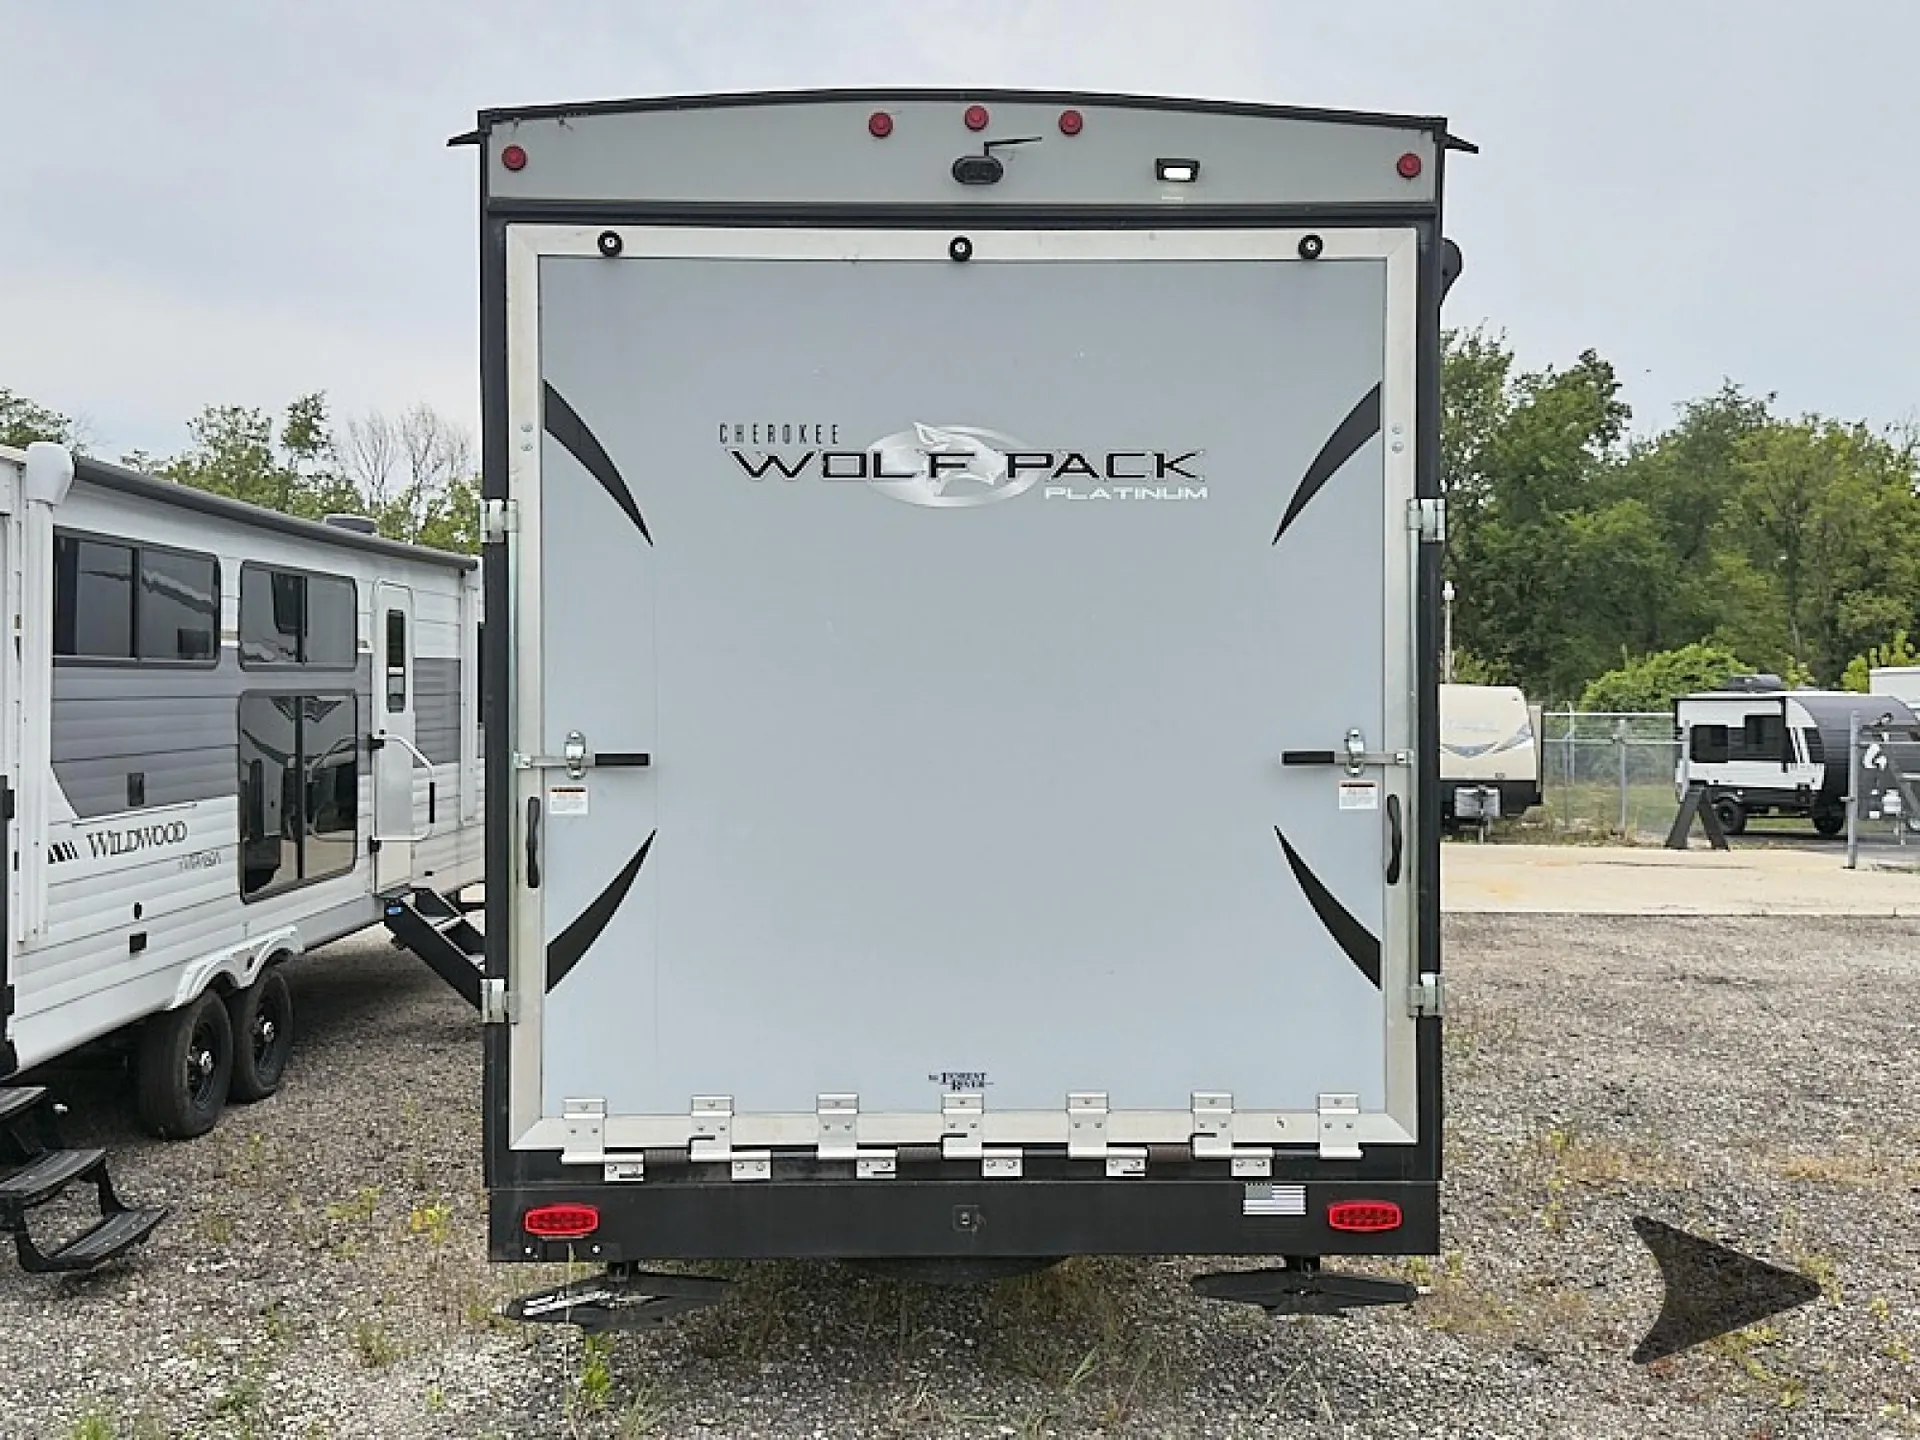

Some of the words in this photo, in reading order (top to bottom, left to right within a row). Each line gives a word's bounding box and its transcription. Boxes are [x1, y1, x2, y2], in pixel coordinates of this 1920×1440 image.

[719, 424, 839, 445] CHEROKEE
[729, 450, 975, 479] WOLF
[1005, 452, 1199, 479] PACK
[1045, 486, 1208, 500] PLATINUM
